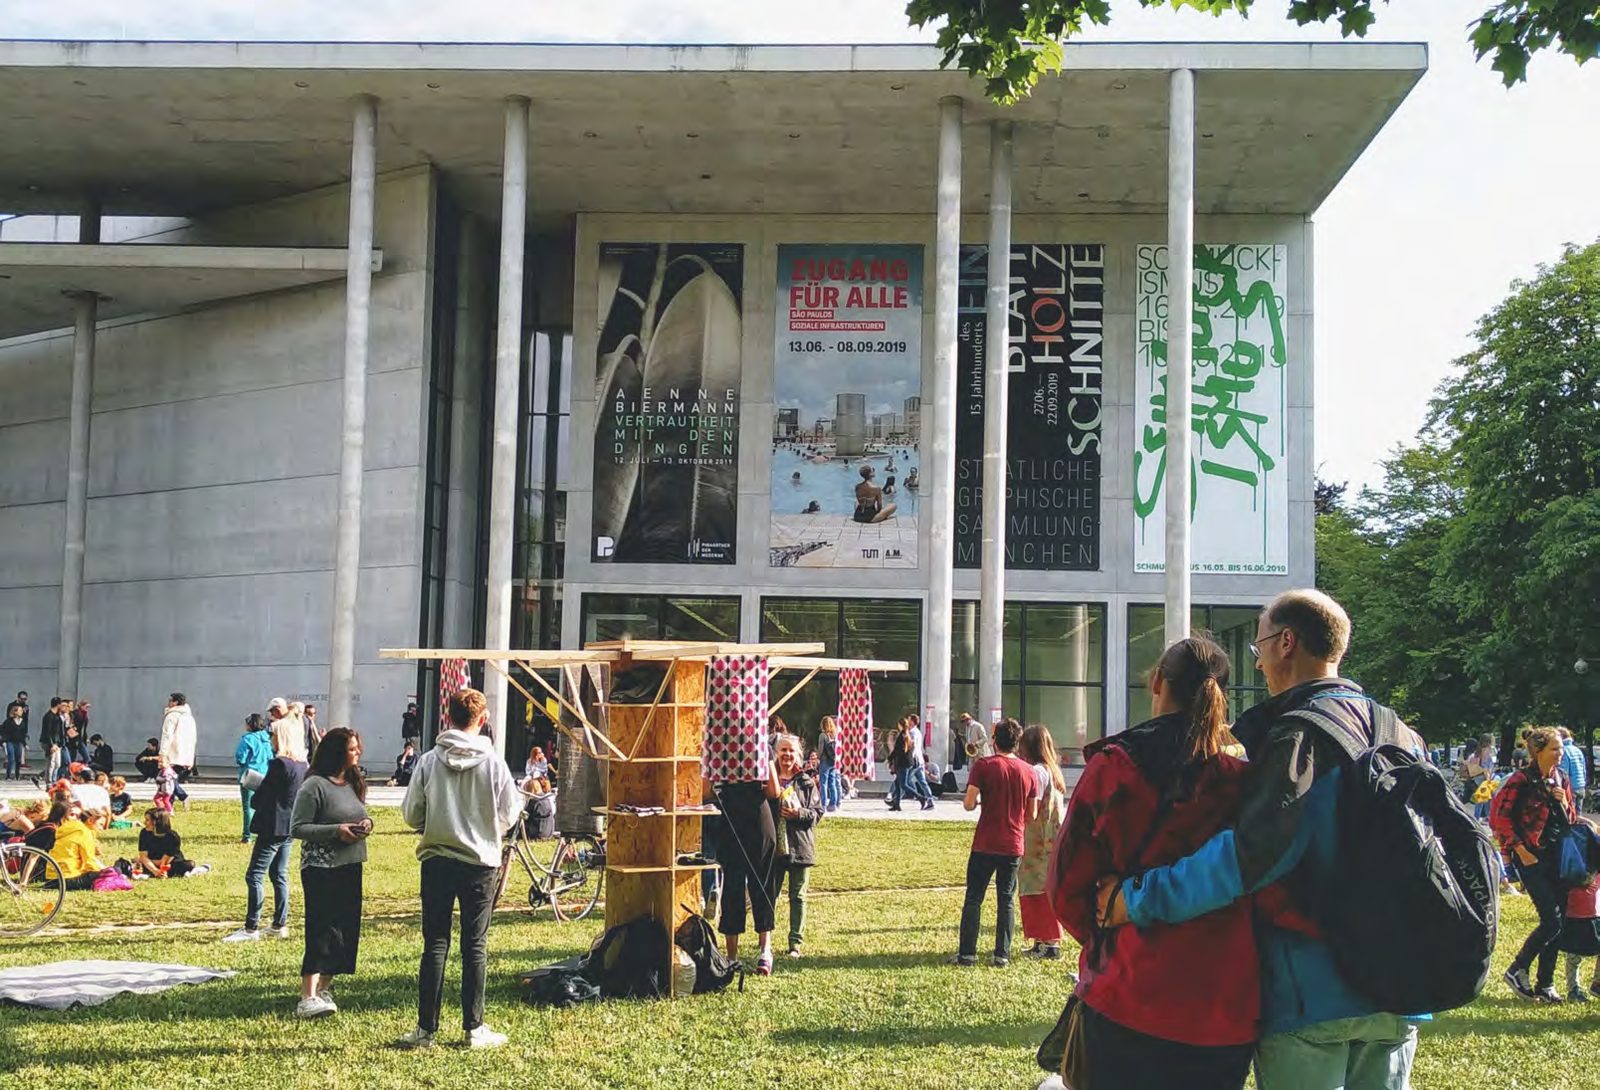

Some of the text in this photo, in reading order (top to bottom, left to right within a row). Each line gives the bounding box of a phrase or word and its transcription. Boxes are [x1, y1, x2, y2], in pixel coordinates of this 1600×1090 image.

[791, 258, 908, 281] ZUGANG
[790, 281, 907, 308] FÜR ALLE
[1031, 245, 1066, 363] HOLZ
[807, 311, 833, 319] PAULOS
[791, 322, 884, 330] SOZIALE INFRASTRUKTUREN
[959, 321, 970, 341] des
[789, 341, 826, 352] 13.06.
[837, 341, 907, 353] 08.09.2019
[1067, 244, 1104, 456] SCHNITTE
[970, 321, 984, 398] Jahrhunderts
[616, 387, 735, 400] AENNE
[1047, 372, 1059, 425] 22.09.2019
[615, 401, 734, 413] BIERMANN
[615, 415, 734, 427] VERTRAUTHEIT
[615, 429, 733, 441] MIT DEN
[614, 442, 733, 455] DINGEN
[959, 458, 1093, 481] STATLICHE
[958, 486, 1093, 509] GRPHISCHE
[958, 514, 1093, 537] SAMLUNG
[958, 541, 1093, 564] MNCHEN
[1136, 563, 1200, 572] SCHMUUS
[1228, 564, 1241, 572] BIS
